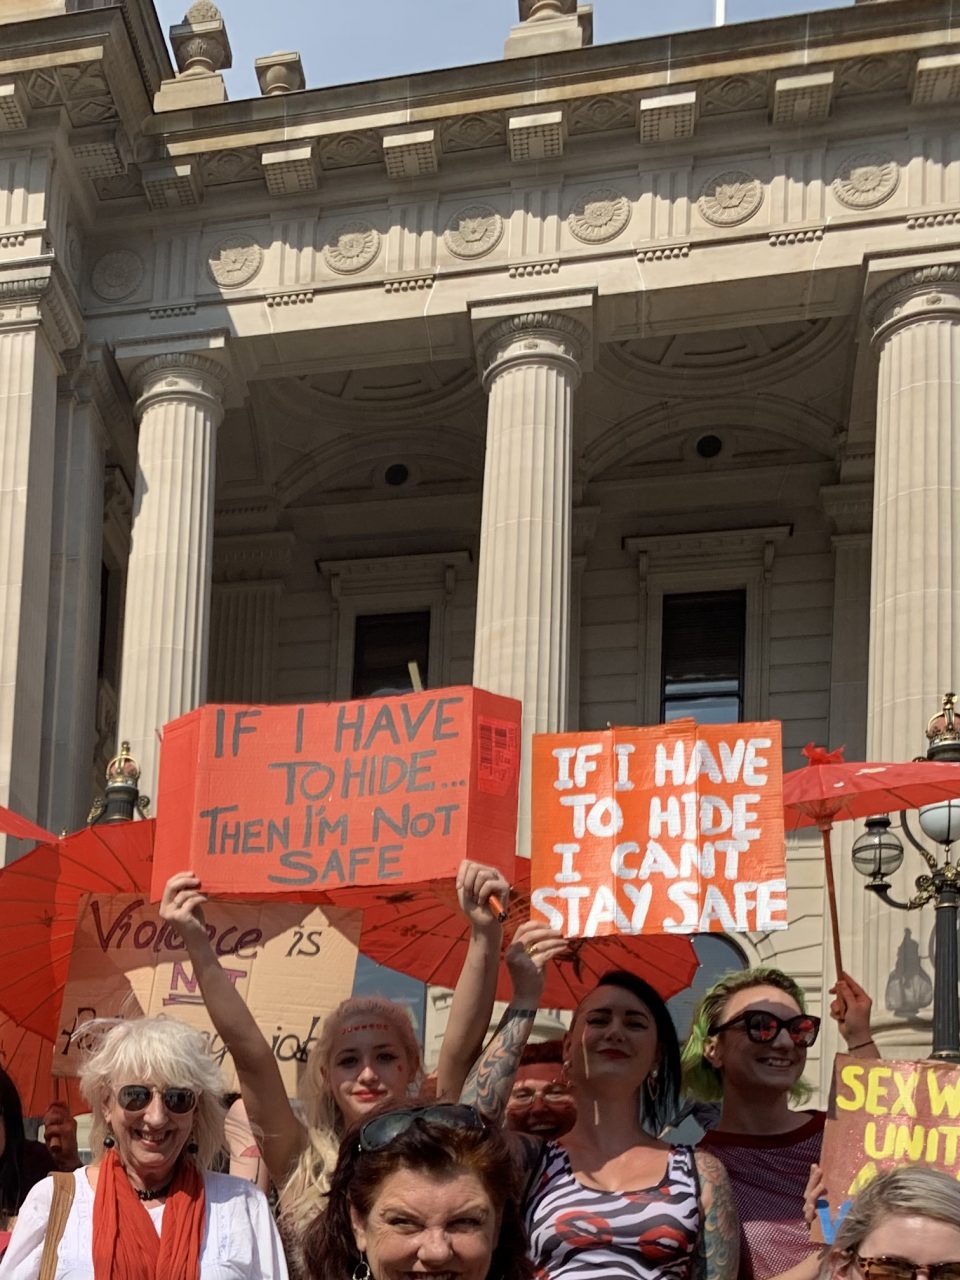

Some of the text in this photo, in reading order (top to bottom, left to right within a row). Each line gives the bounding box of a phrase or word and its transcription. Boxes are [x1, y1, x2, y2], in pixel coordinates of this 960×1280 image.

[214, 697, 465, 758] IF I HAVE
[267, 761, 335, 805] TO
[551, 743, 603, 791] IF
[614, 743, 636, 791] I
[654, 738, 772, 787] HAVE
[559, 791, 761, 841] TO HIDE
[267, 844, 404, 885] SAFE
[553, 839, 750, 883] I CANT
[530, 879, 789, 938] STAY SAFE
[171, 960, 247, 994] NT
[836, 1065, 920, 1118] SEX
